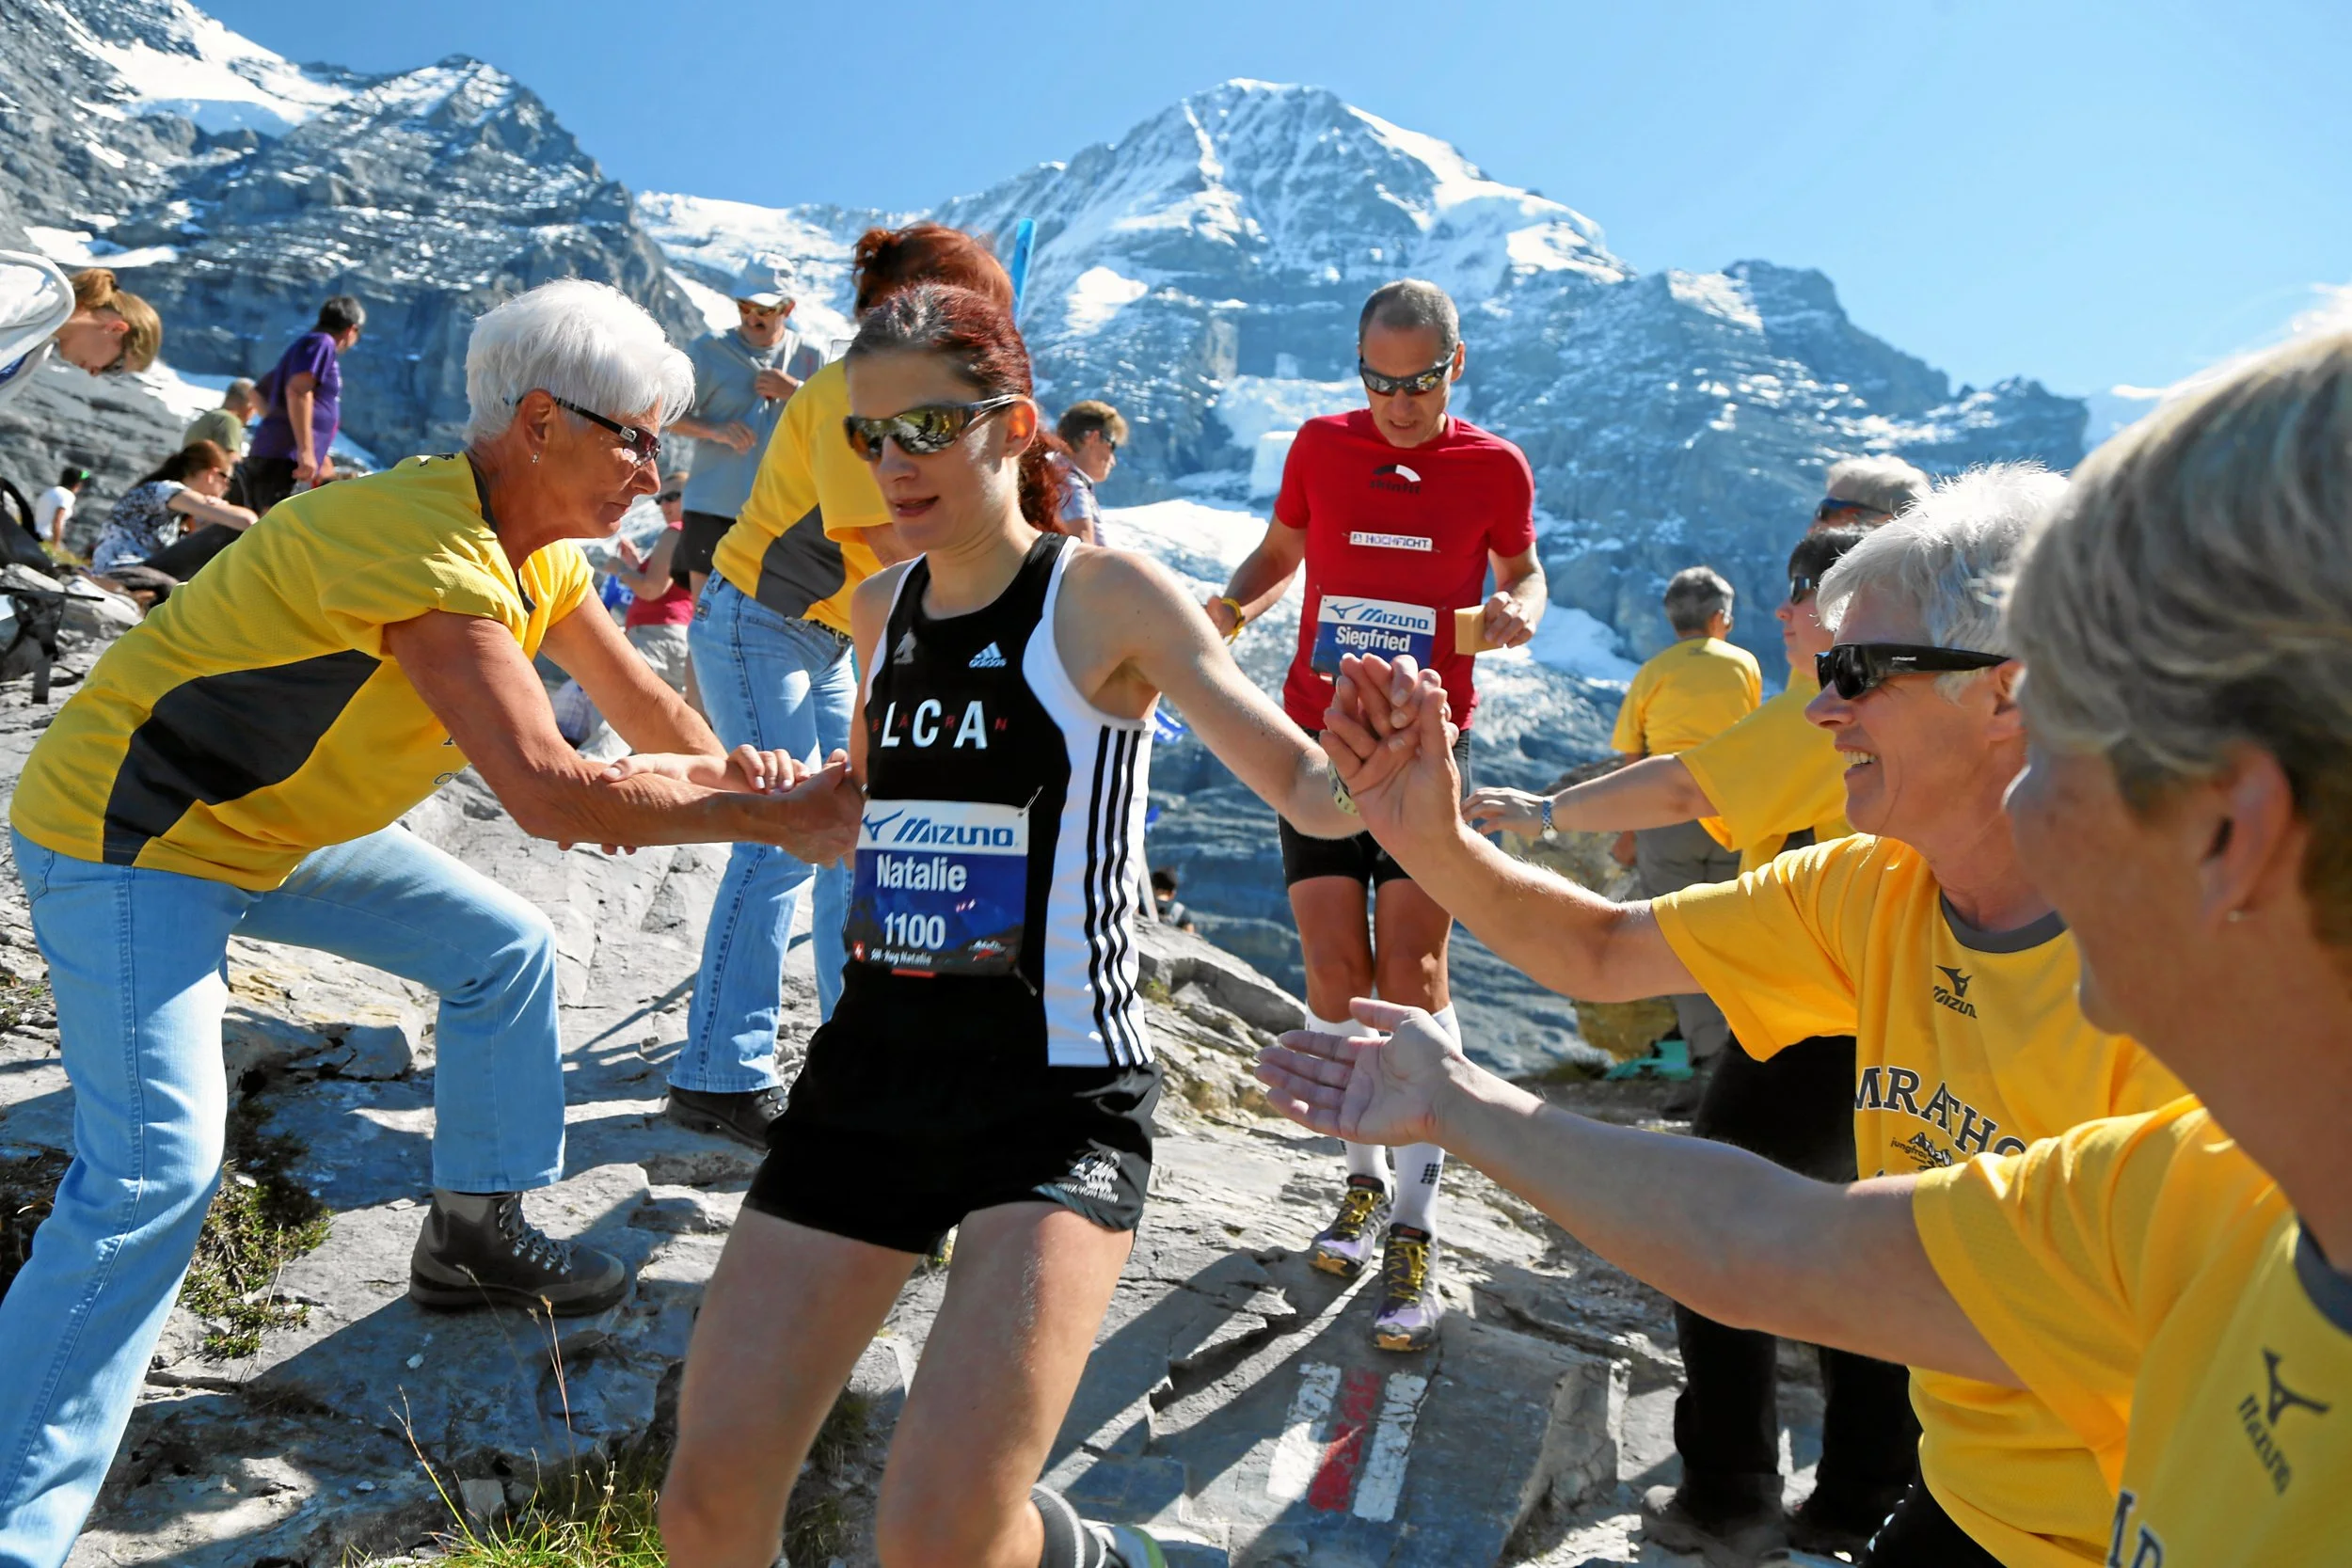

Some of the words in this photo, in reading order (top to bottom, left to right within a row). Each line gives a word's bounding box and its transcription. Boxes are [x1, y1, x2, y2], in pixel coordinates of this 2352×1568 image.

[1335, 626, 1411, 653] Siegfried
[968, 657, 1008, 669] adidas
[876, 852, 968, 893] Natalie
[883, 912, 946, 949] 1100
